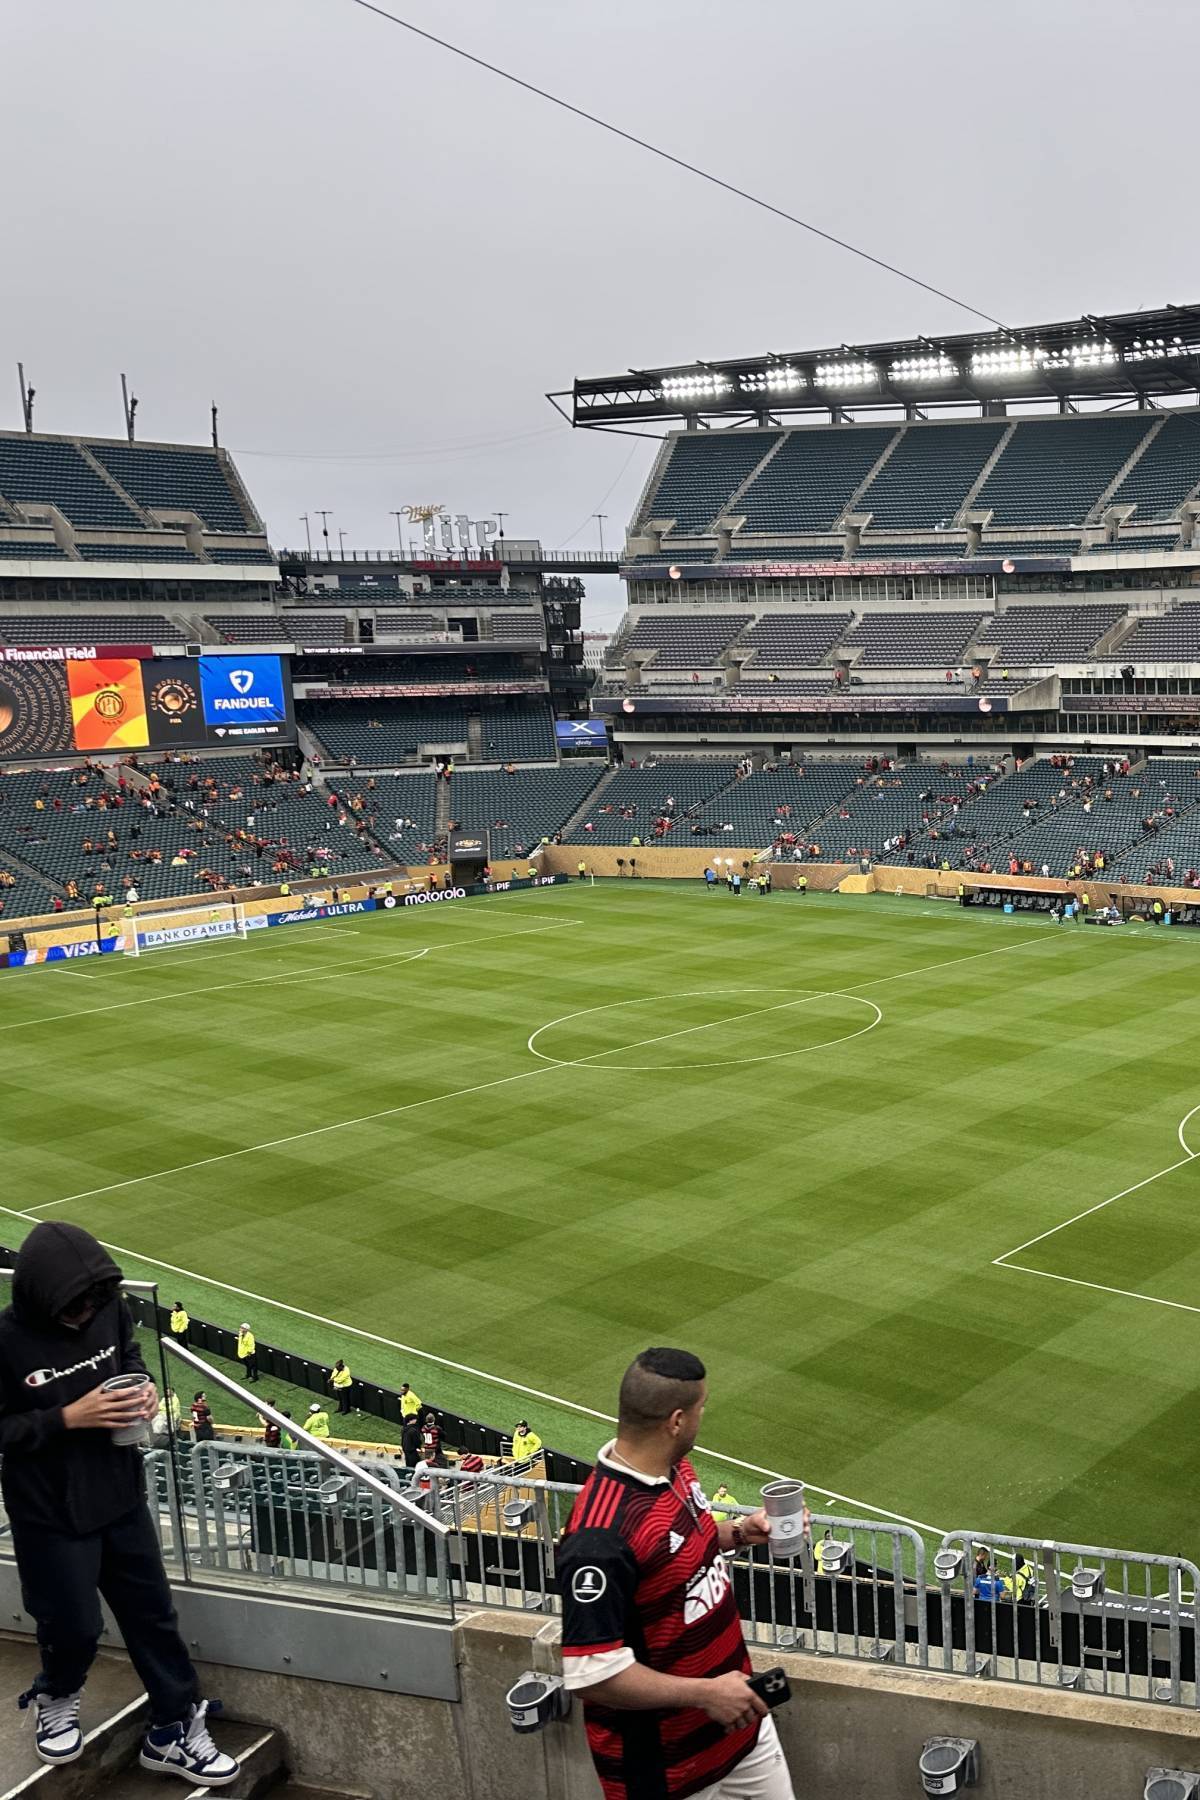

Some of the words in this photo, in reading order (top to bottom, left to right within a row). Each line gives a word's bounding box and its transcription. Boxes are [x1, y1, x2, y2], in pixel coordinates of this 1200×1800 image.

[5, 648, 64, 661] Financial
[65, 647, 97, 660] Field
[213, 697, 274, 710] FANDUEL
[496, 880, 511, 892] PIF
[541, 874, 556, 886] PIF
[404, 886, 466, 905] motorola
[327, 902, 365, 917] ULTRA
[147, 927, 181, 944] BANK
[183, 922, 198, 937] OF
[200, 919, 251, 935] AMERICA
[61, 941, 101, 957] VISA
[25, 1346, 116, 1387] Champio
